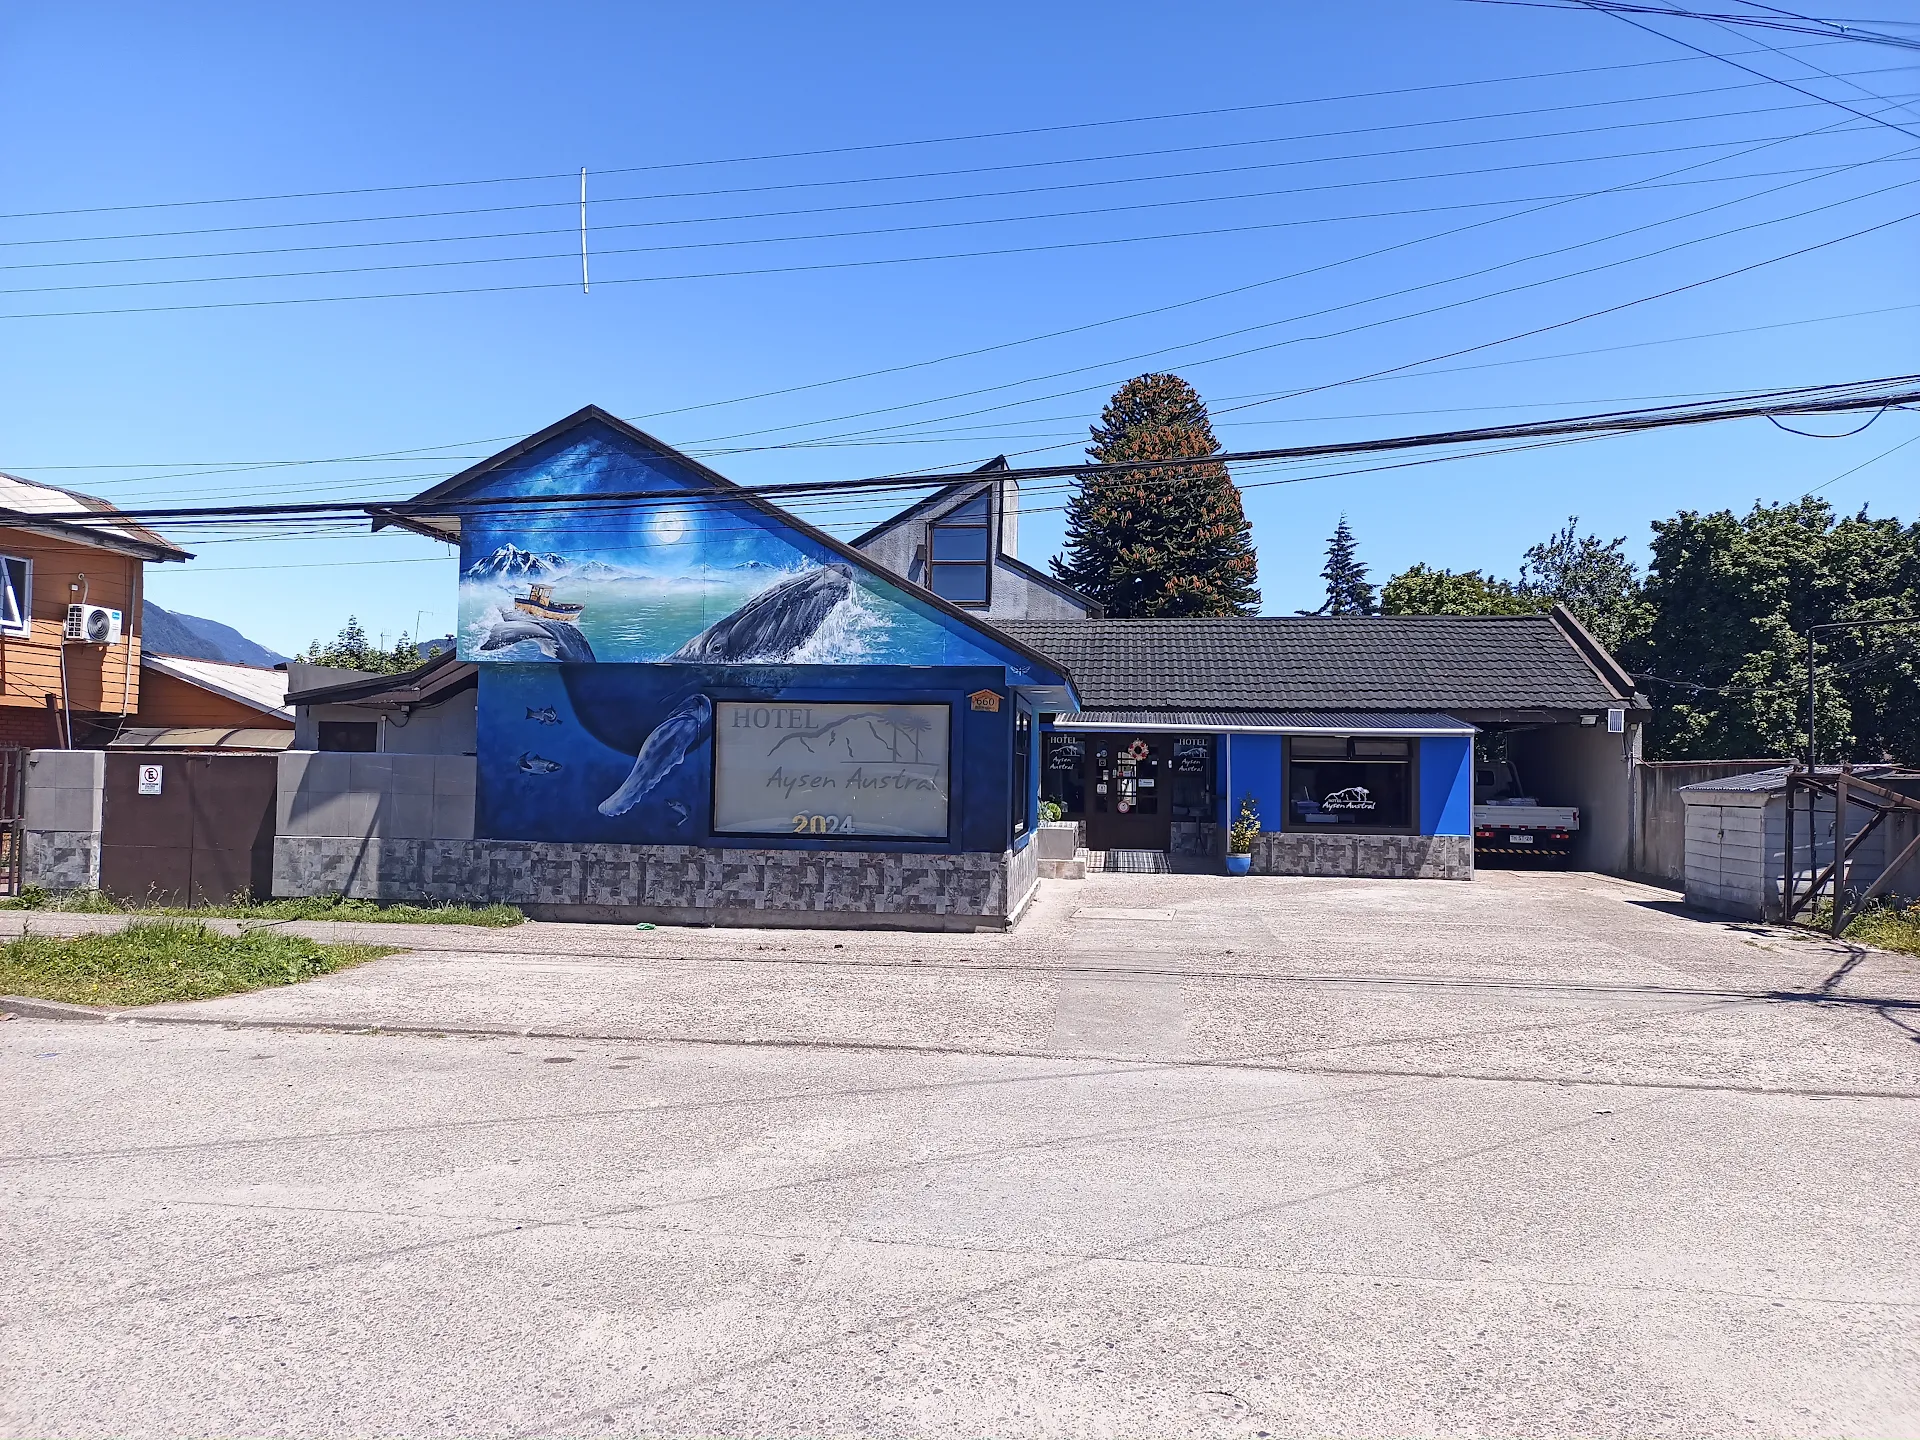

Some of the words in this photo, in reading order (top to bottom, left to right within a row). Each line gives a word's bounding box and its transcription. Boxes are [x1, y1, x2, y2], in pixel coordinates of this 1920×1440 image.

[976, 697, 995, 706] 660
[732, 708, 819, 729] HOTEL
[1050, 736, 1078, 744] HOTEL
[1179, 738, 1208, 746] HOTEL
[766, 766, 836, 799] Aysen
[845, 767, 940, 791] Austral
[1322, 802, 1345, 811] Aysen
[792, 814, 857, 834] 2024
